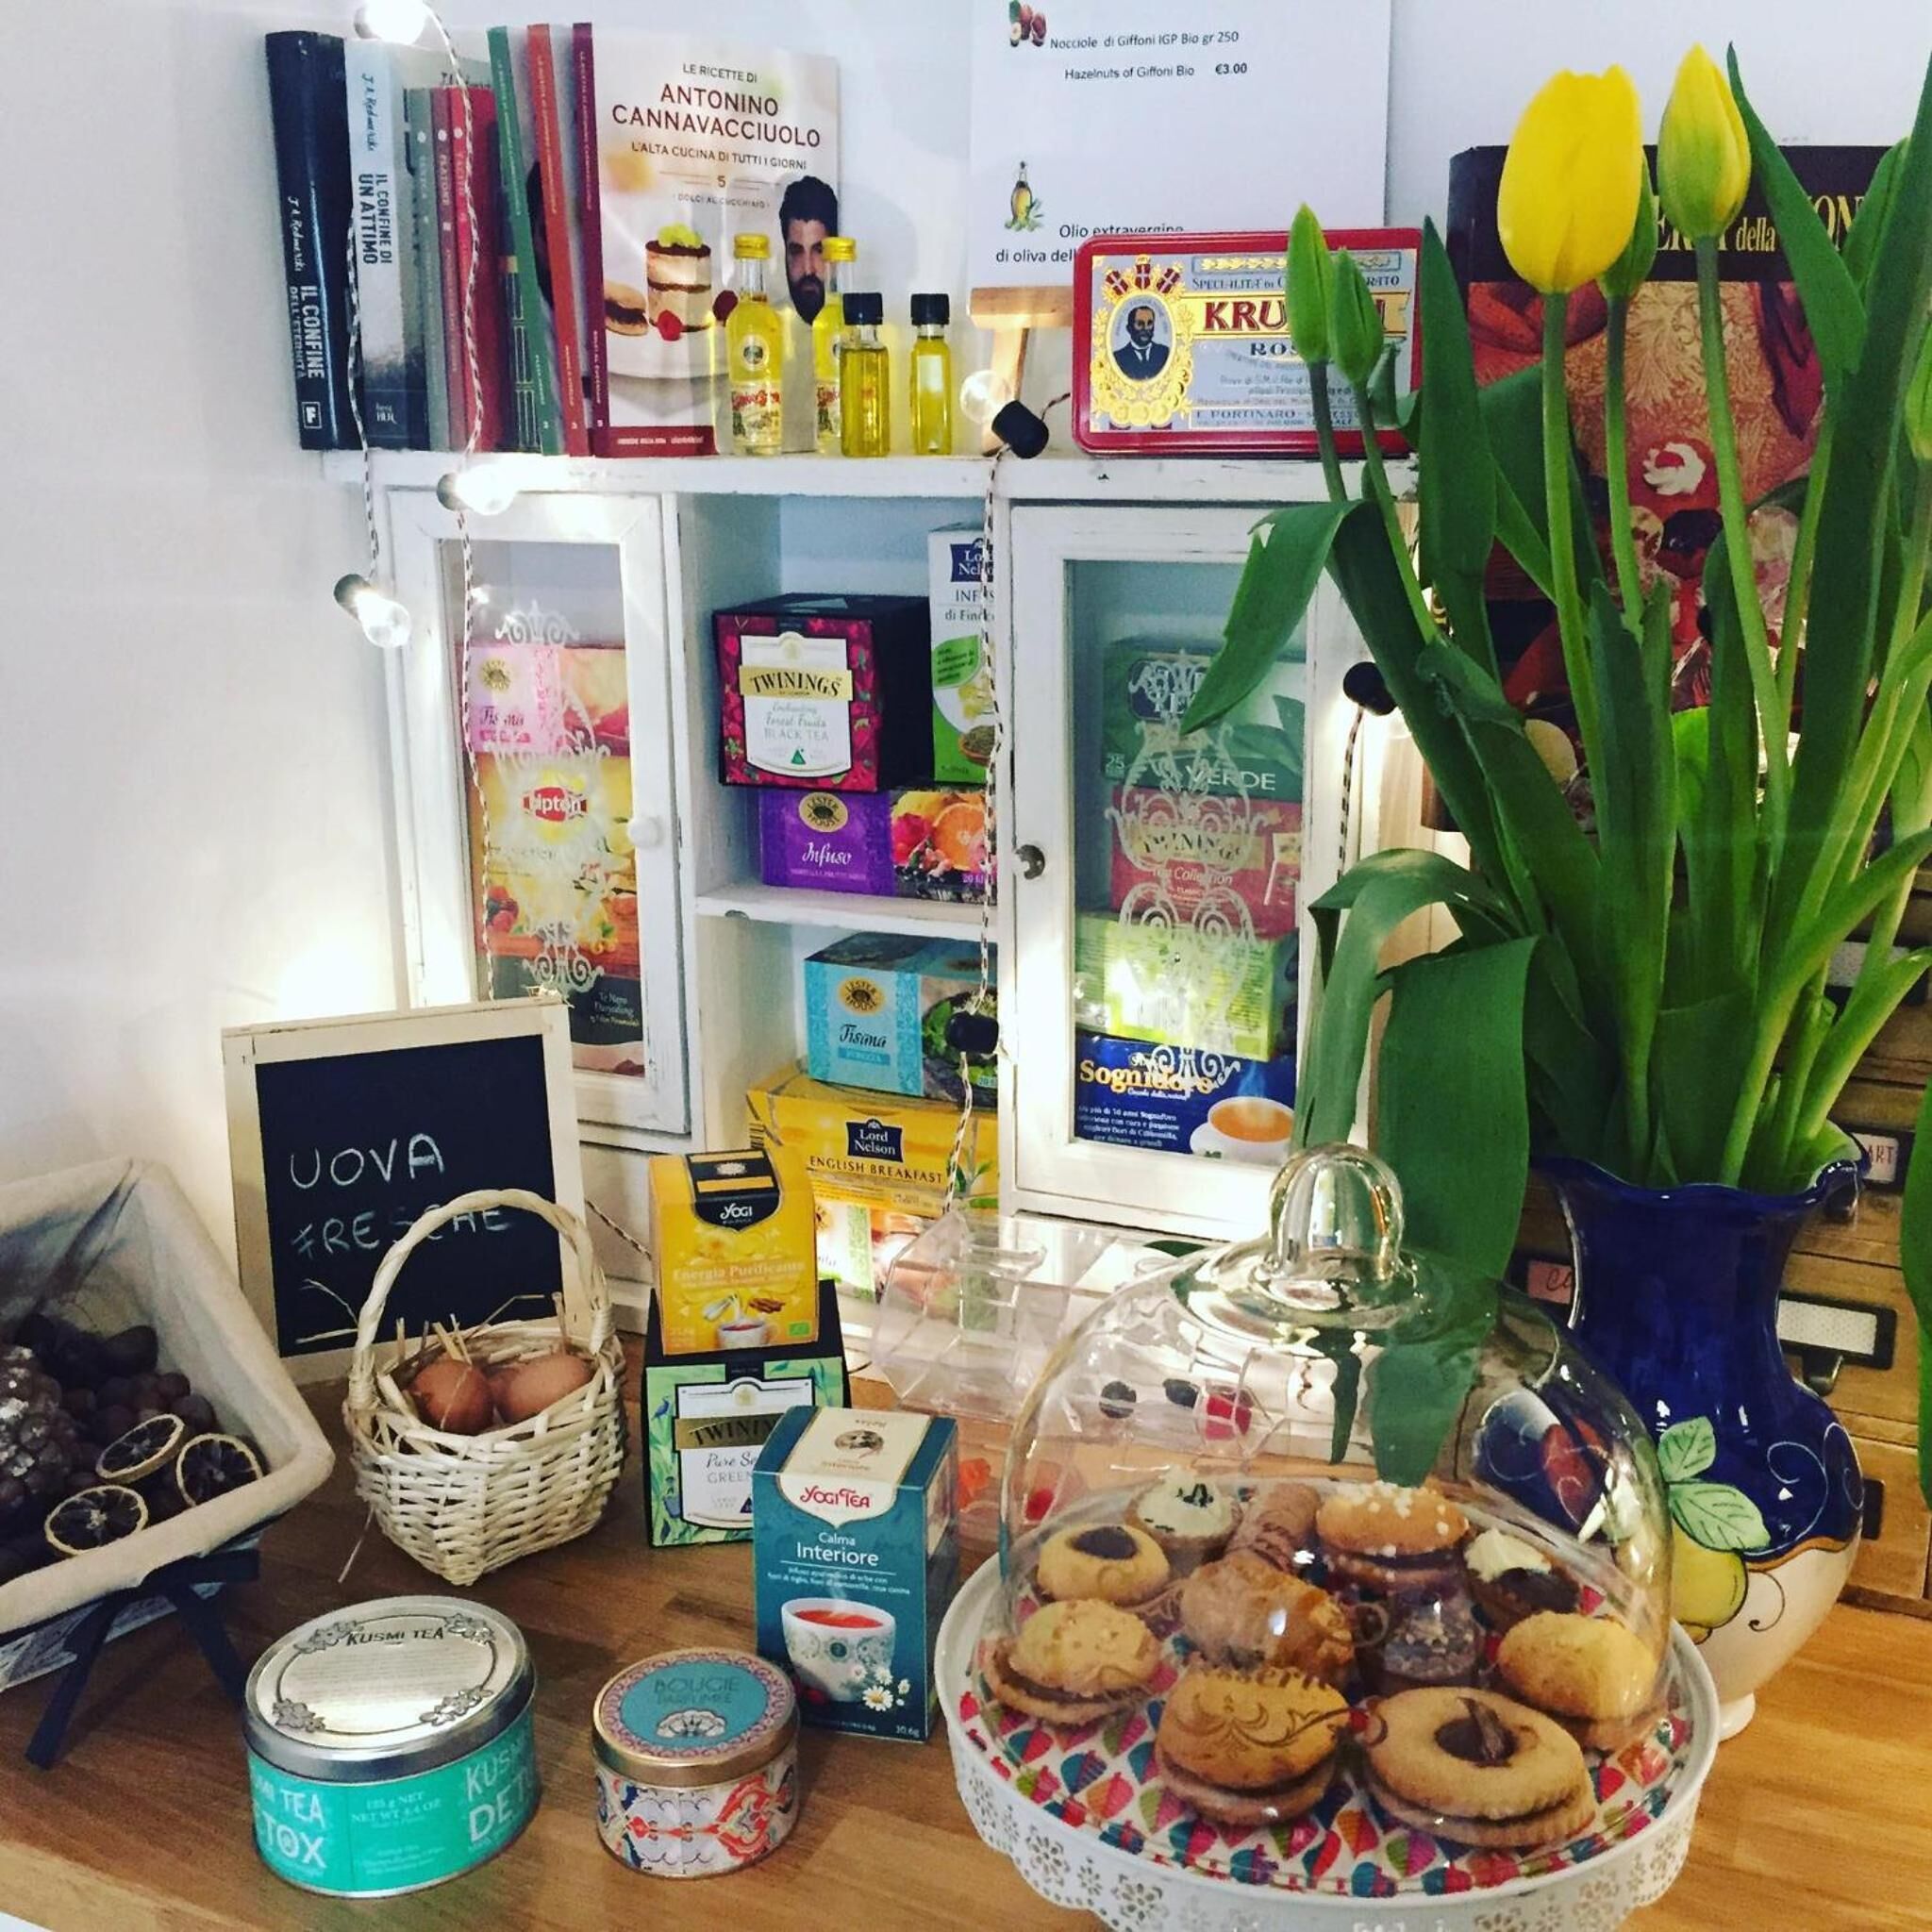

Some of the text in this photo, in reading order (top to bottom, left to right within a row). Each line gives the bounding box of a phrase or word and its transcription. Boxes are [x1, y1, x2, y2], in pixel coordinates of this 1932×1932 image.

[1050, 31, 1239, 49] Nocciole di Giffoni IGP Bio gr 250
[683, 62, 758, 83] LE RICETTE DI
[1064, 67, 1120, 79] Hazelnuts
[1123, 67, 1133, 78] of
[1136, 65, 1174, 77] Giffoni
[1176, 65, 1194, 76] Bio
[660, 83, 778, 117] ANTONINO
[612, 104, 821, 148] CANNAVACCIUOLO
[631, 142, 669, 156] L'ALTA
[672, 146, 716, 161] CUCINA
[718, 151, 730, 162] DI
[731, 153, 762, 166] TUTTI
[770, 158, 808, 171] GIORNI
[717, 175, 726, 188] 5
[358, 174, 378, 265] UN ATTIMO
[375, 174, 392, 264] IL CONFINE DI
[1058, 224, 1089, 238] Olio
[1736, 217, 1776, 252] della
[996, 248, 1008, 262] di
[1012, 248, 1047, 262] oliva
[300, 285, 325, 379] IL CONFINE
[751, 671, 841, 697] TWININGS
[1105, 756, 1125, 769] 25
[802, 841, 853, 867] Infuso
[1174, 866, 1233, 885] Colleion
[839, 1024, 888, 1048] Tisana
[859, 1128, 889, 1142] Lord
[855, 1140, 896, 1156] Nelson
[291, 1133, 445, 1190] UOVA
[809, 1155, 942, 1184] ENGLISH BREAKFAST
[719, 1202, 753, 1220] YOGI
[291, 1204, 515, 1260] FREHE
[706, 1452, 737, 1469] Pure
[800, 1485, 871, 1508] YOGI TEA
[818, 1531, 857, 1547] Calma
[796, 1541, 879, 1567] Interiore
[346, 1626, 444, 1646] KUSMI TEA
[279, 1790, 325, 1829] TEA
[398, 1791, 425, 1806] NET
[351, 1811, 377, 1824] NET
[379, 1810, 399, 1822] WT
